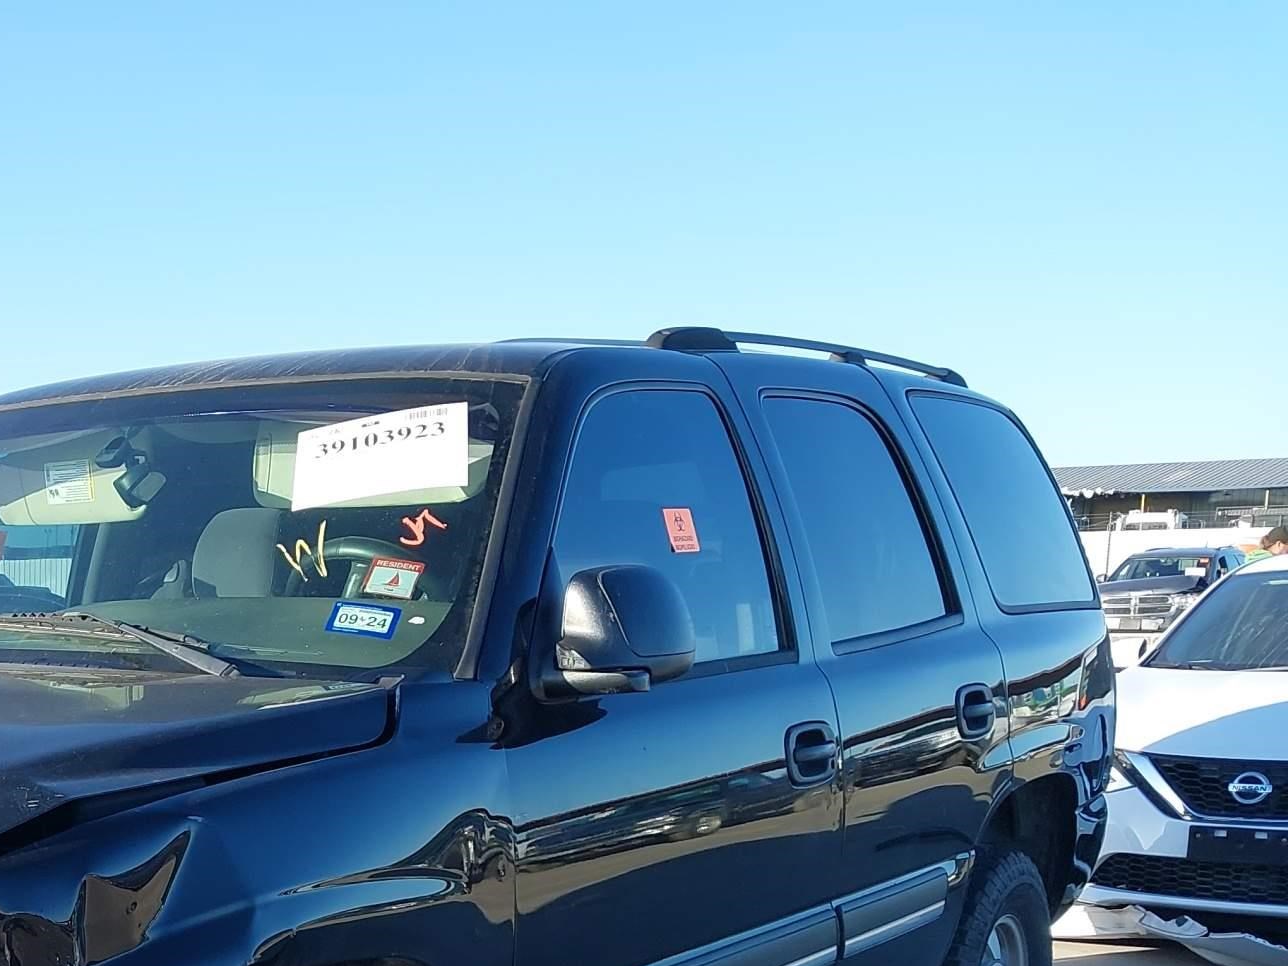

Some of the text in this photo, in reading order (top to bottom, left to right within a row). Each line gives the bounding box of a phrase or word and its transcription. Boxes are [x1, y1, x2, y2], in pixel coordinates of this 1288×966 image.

[315, 421, 446, 459] 39103923
[376, 559, 423, 572] RESIDENT
[338, 613, 359, 625] 09
[366, 616, 387, 629] 24
